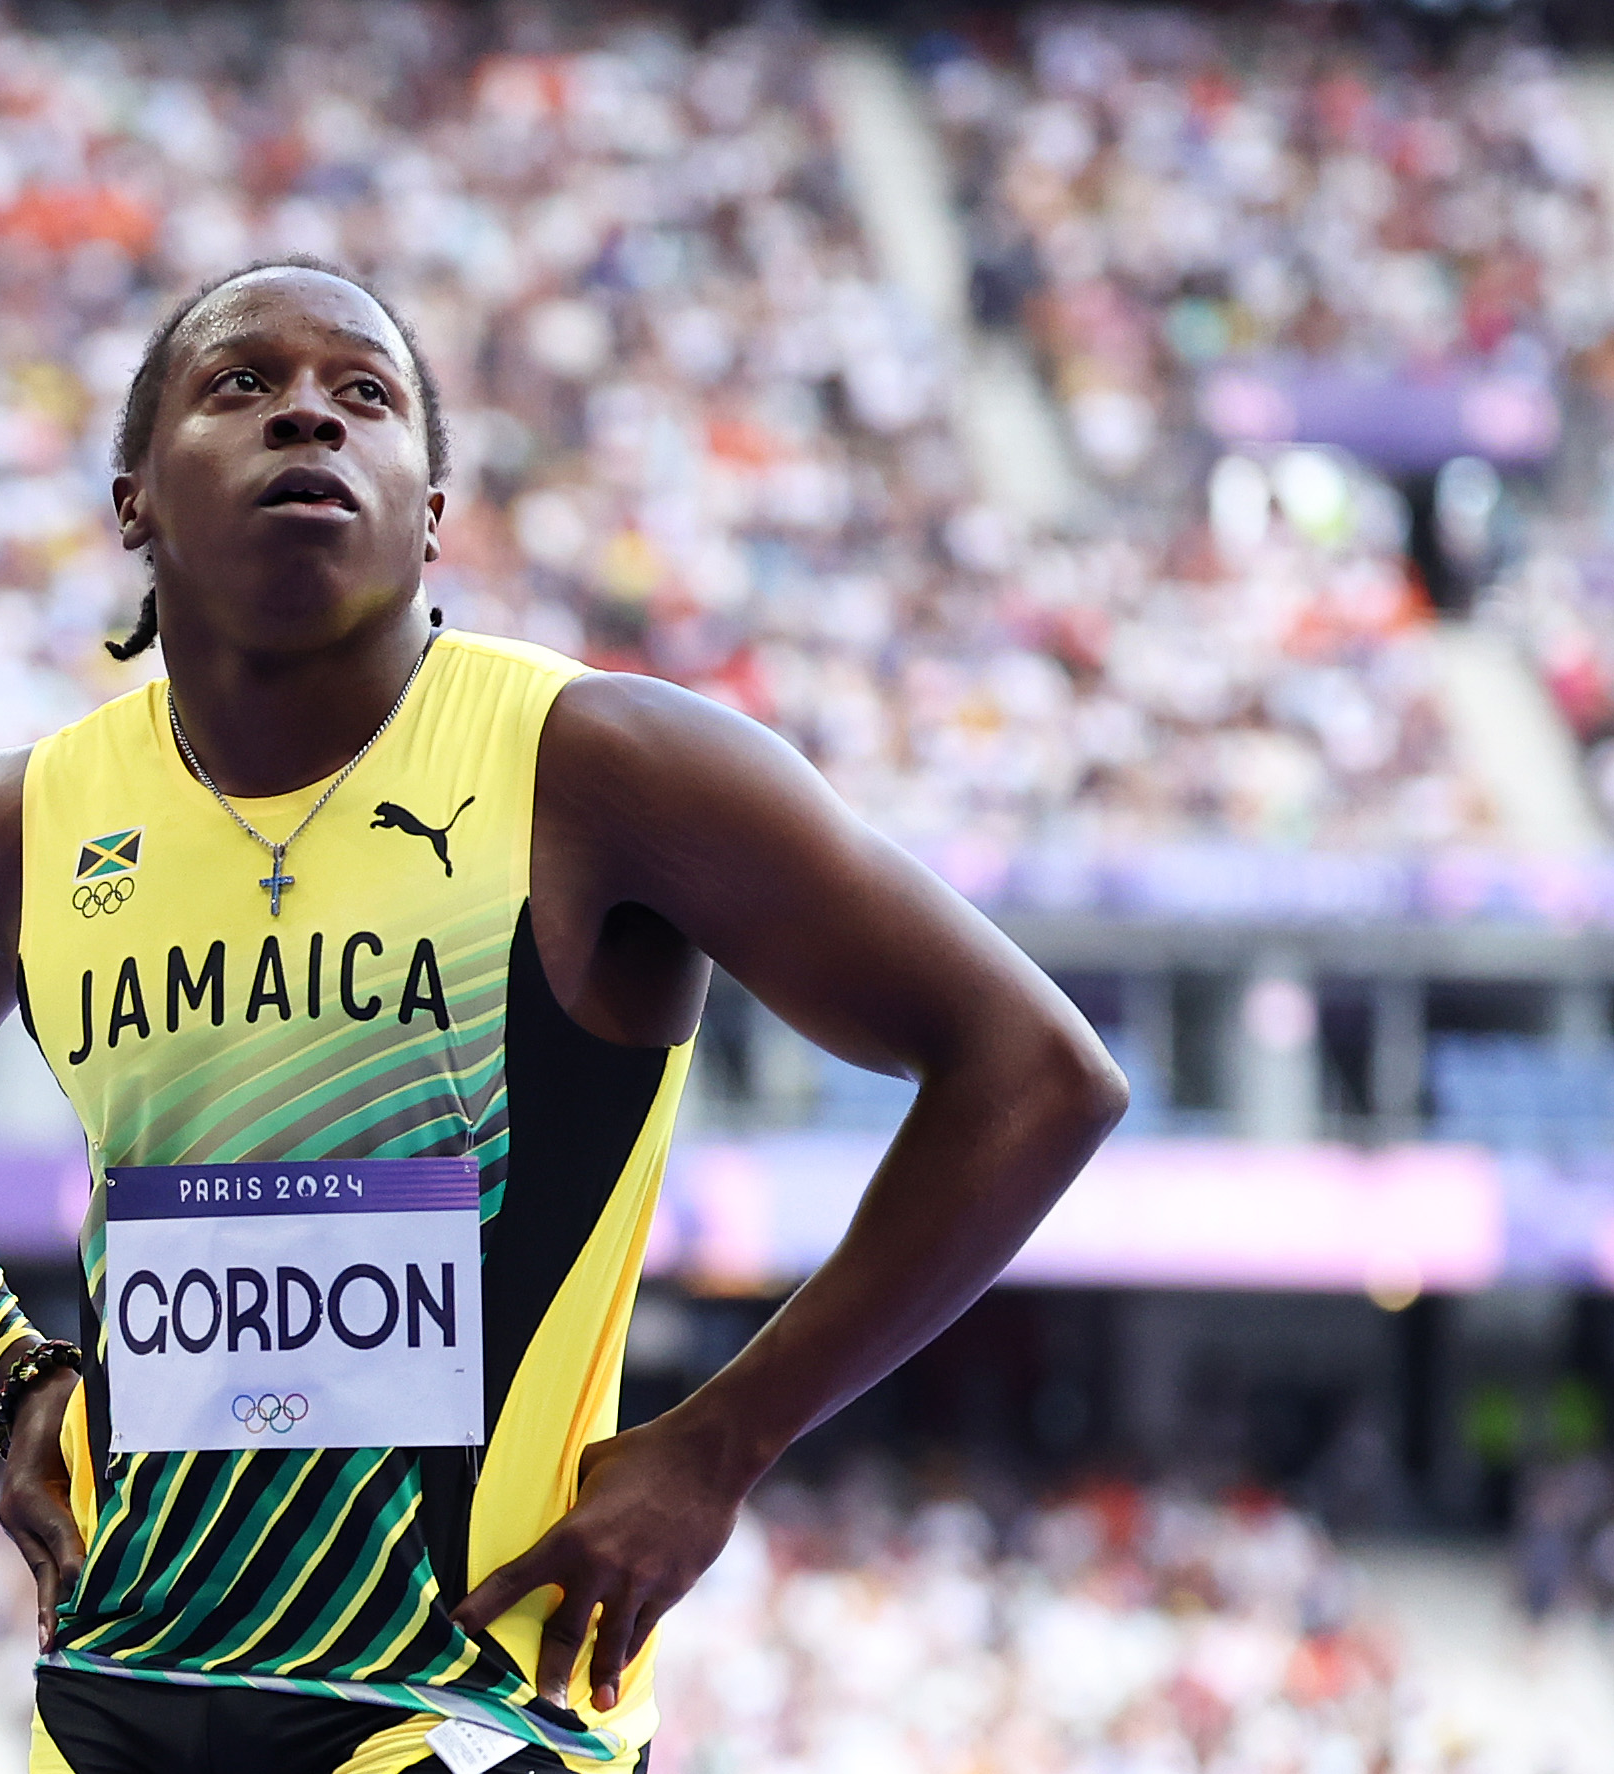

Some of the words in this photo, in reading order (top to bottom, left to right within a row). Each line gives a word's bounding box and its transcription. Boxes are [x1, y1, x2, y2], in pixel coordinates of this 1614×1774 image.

[69, 931, 450, 1066] JAMAICA
[274, 1173, 364, 1199] 2024
[118, 1262, 457, 1356] GORDON
